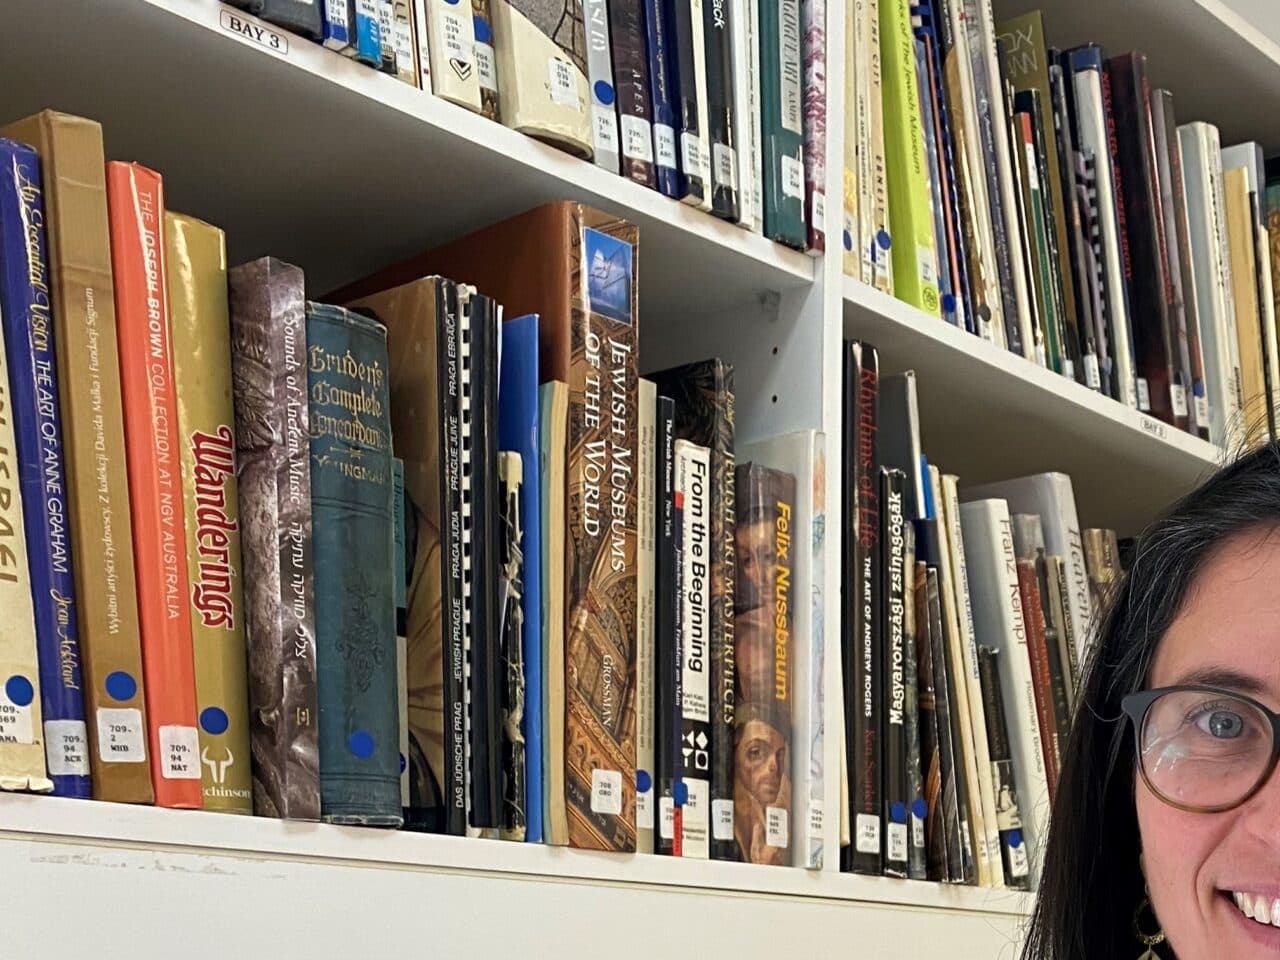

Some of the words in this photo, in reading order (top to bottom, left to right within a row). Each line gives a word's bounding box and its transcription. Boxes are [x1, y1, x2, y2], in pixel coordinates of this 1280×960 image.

[229, 15, 264, 41] BAY
[269, 33, 280, 49] 3
[872, 53, 880, 89] CITY
[903, 64, 915, 112] Jewish
[908, 114, 922, 174] Museum
[138, 190, 153, 226] THE
[143, 227, 159, 295] JOSEPH
[28, 291, 51, 352] Vision
[147, 295, 164, 360] BROWN
[448, 312, 456, 360] EBRAICA
[283, 317, 298, 371] Sounds
[584, 332, 600, 366] OF
[34, 359, 52, 388] THE
[448, 362, 457, 397] PRAGA
[607, 336, 633, 437] JEWISH
[38, 387, 55, 420] ART
[151, 361, 171, 470] COLLECTION
[312, 380, 383, 419] Complete
[584, 371, 600, 430] THE
[858, 368, 878, 471] Rhythms
[41, 422, 58, 449] OF
[285, 397, 301, 457] Ancient
[449, 416, 458, 446] JUIVE
[665, 419, 673, 434] The
[665, 433, 673, 459] Jewish
[43, 447, 62, 495] ANNE
[158, 471, 174, 490] AT
[287, 458, 303, 504] Music
[450, 450, 459, 491] PRAGUE
[583, 438, 607, 536] WORLD
[664, 460, 672, 493] Museum
[691, 459, 706, 518] From
[721, 449, 736, 523] JEWISH
[161, 494, 176, 528] NGV
[189, 422, 238, 630] Wanderings
[451, 511, 460, 542] JUDIA
[608, 440, 633, 572] MUSEUMS
[858, 503, 878, 548] Life
[47, 499, 68, 574] GRAHAM
[691, 522, 706, 558] the
[723, 529, 735, 567] ART
[775, 500, 792, 560] Felix
[888, 491, 905, 593] zsinagógák
[163, 530, 180, 621] AUSTRALIA
[452, 543, 461, 579] PRAGA
[864, 556, 872, 580] THE
[999, 518, 1016, 575] Franz
[1009, 583, 1025, 647] Kempf
[864, 582, 872, 606] ART
[864, 606, 872, 621] OF
[453, 598, 462, 642] PRAGUE
[687, 561, 706, 674] Beginning
[774, 565, 791, 700] Nussbaum
[453, 643, 462, 683] JEWISH
[722, 576, 735, 724] MASTERPIECES
[864, 622, 873, 673] ANDREW
[888, 596, 904, 726] Magyarországi
[601, 653, 613, 728] GROSSMAN
[865, 674, 873, 717] ROGERS
[109, 724, 133, 734] 709.
[454, 701, 463, 732] PRAG
[62, 735, 84, 744] 709.
[63, 744, 76, 753] 94
[170, 744, 191, 753] 709.
[170, 754, 183, 763] 94
[454, 732, 463, 785] JÜDISCHE
[171, 764, 188, 772] NAT
[455, 786, 464, 808] DAS
